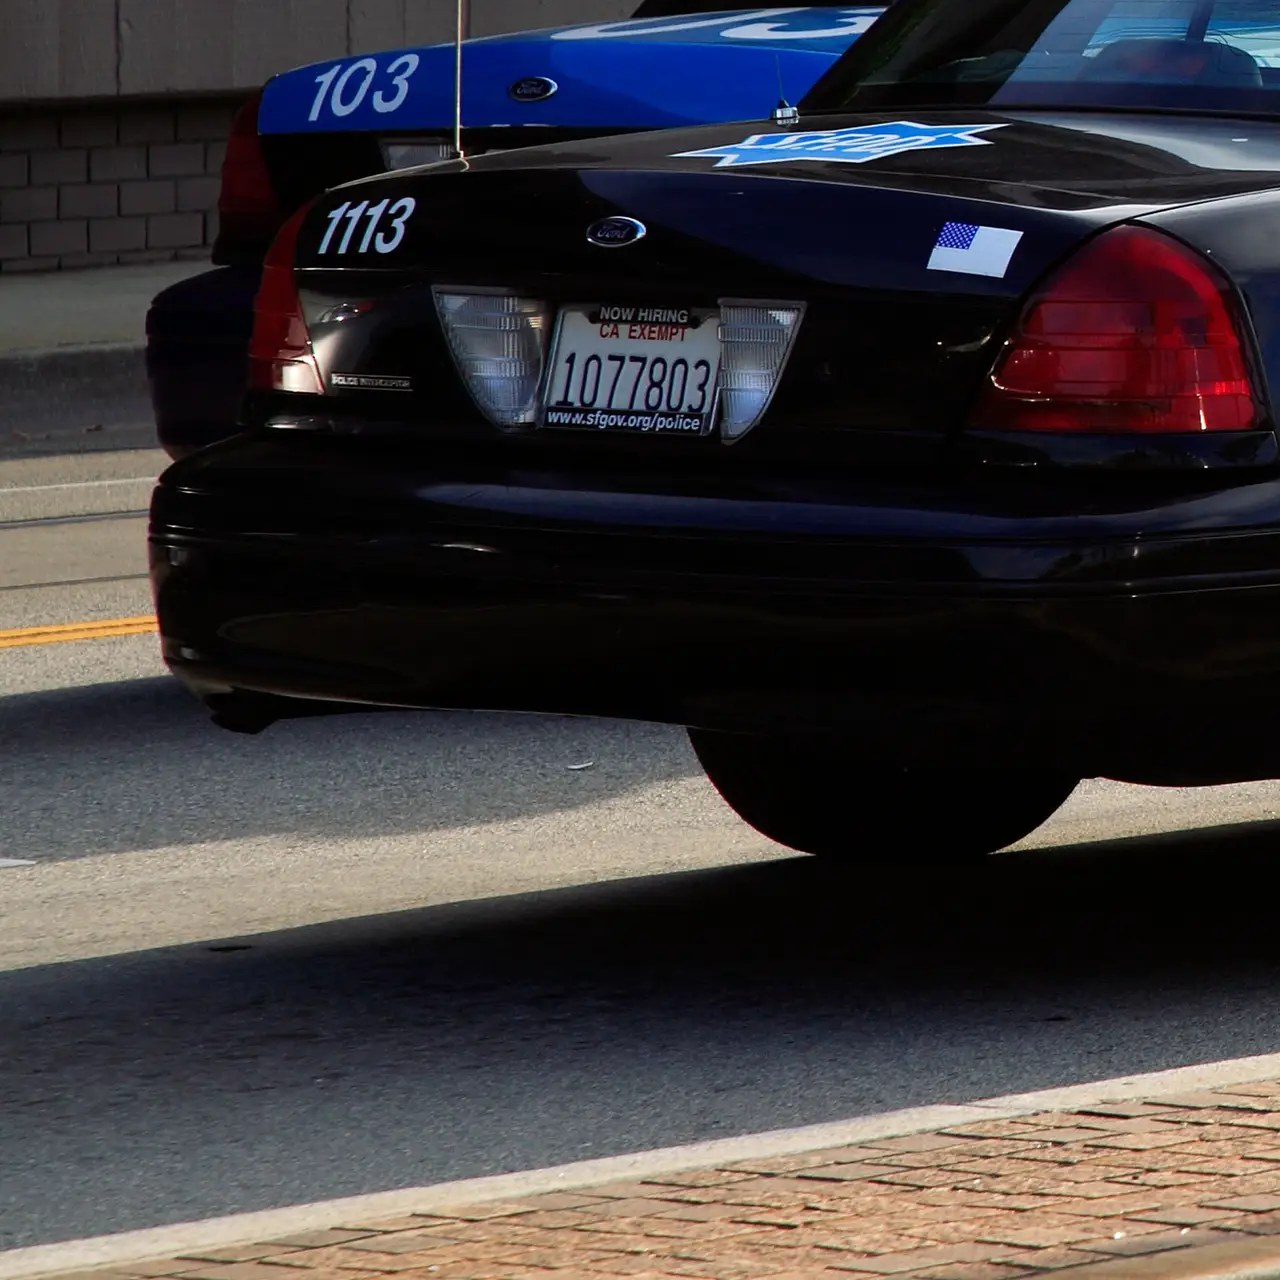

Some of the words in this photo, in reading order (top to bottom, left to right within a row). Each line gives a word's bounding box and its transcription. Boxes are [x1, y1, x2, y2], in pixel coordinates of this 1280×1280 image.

[308, 54, 420, 122] 103
[317, 197, 416, 255] 1113
[600, 306, 637, 320] NOW
[637, 307, 689, 322] HIRING
[600, 323, 620, 338] CA
[628, 324, 688, 341] EXEMPT
[555, 352, 711, 412] 1077803
[548, 410, 700, 431] www.sfgov.org/police
